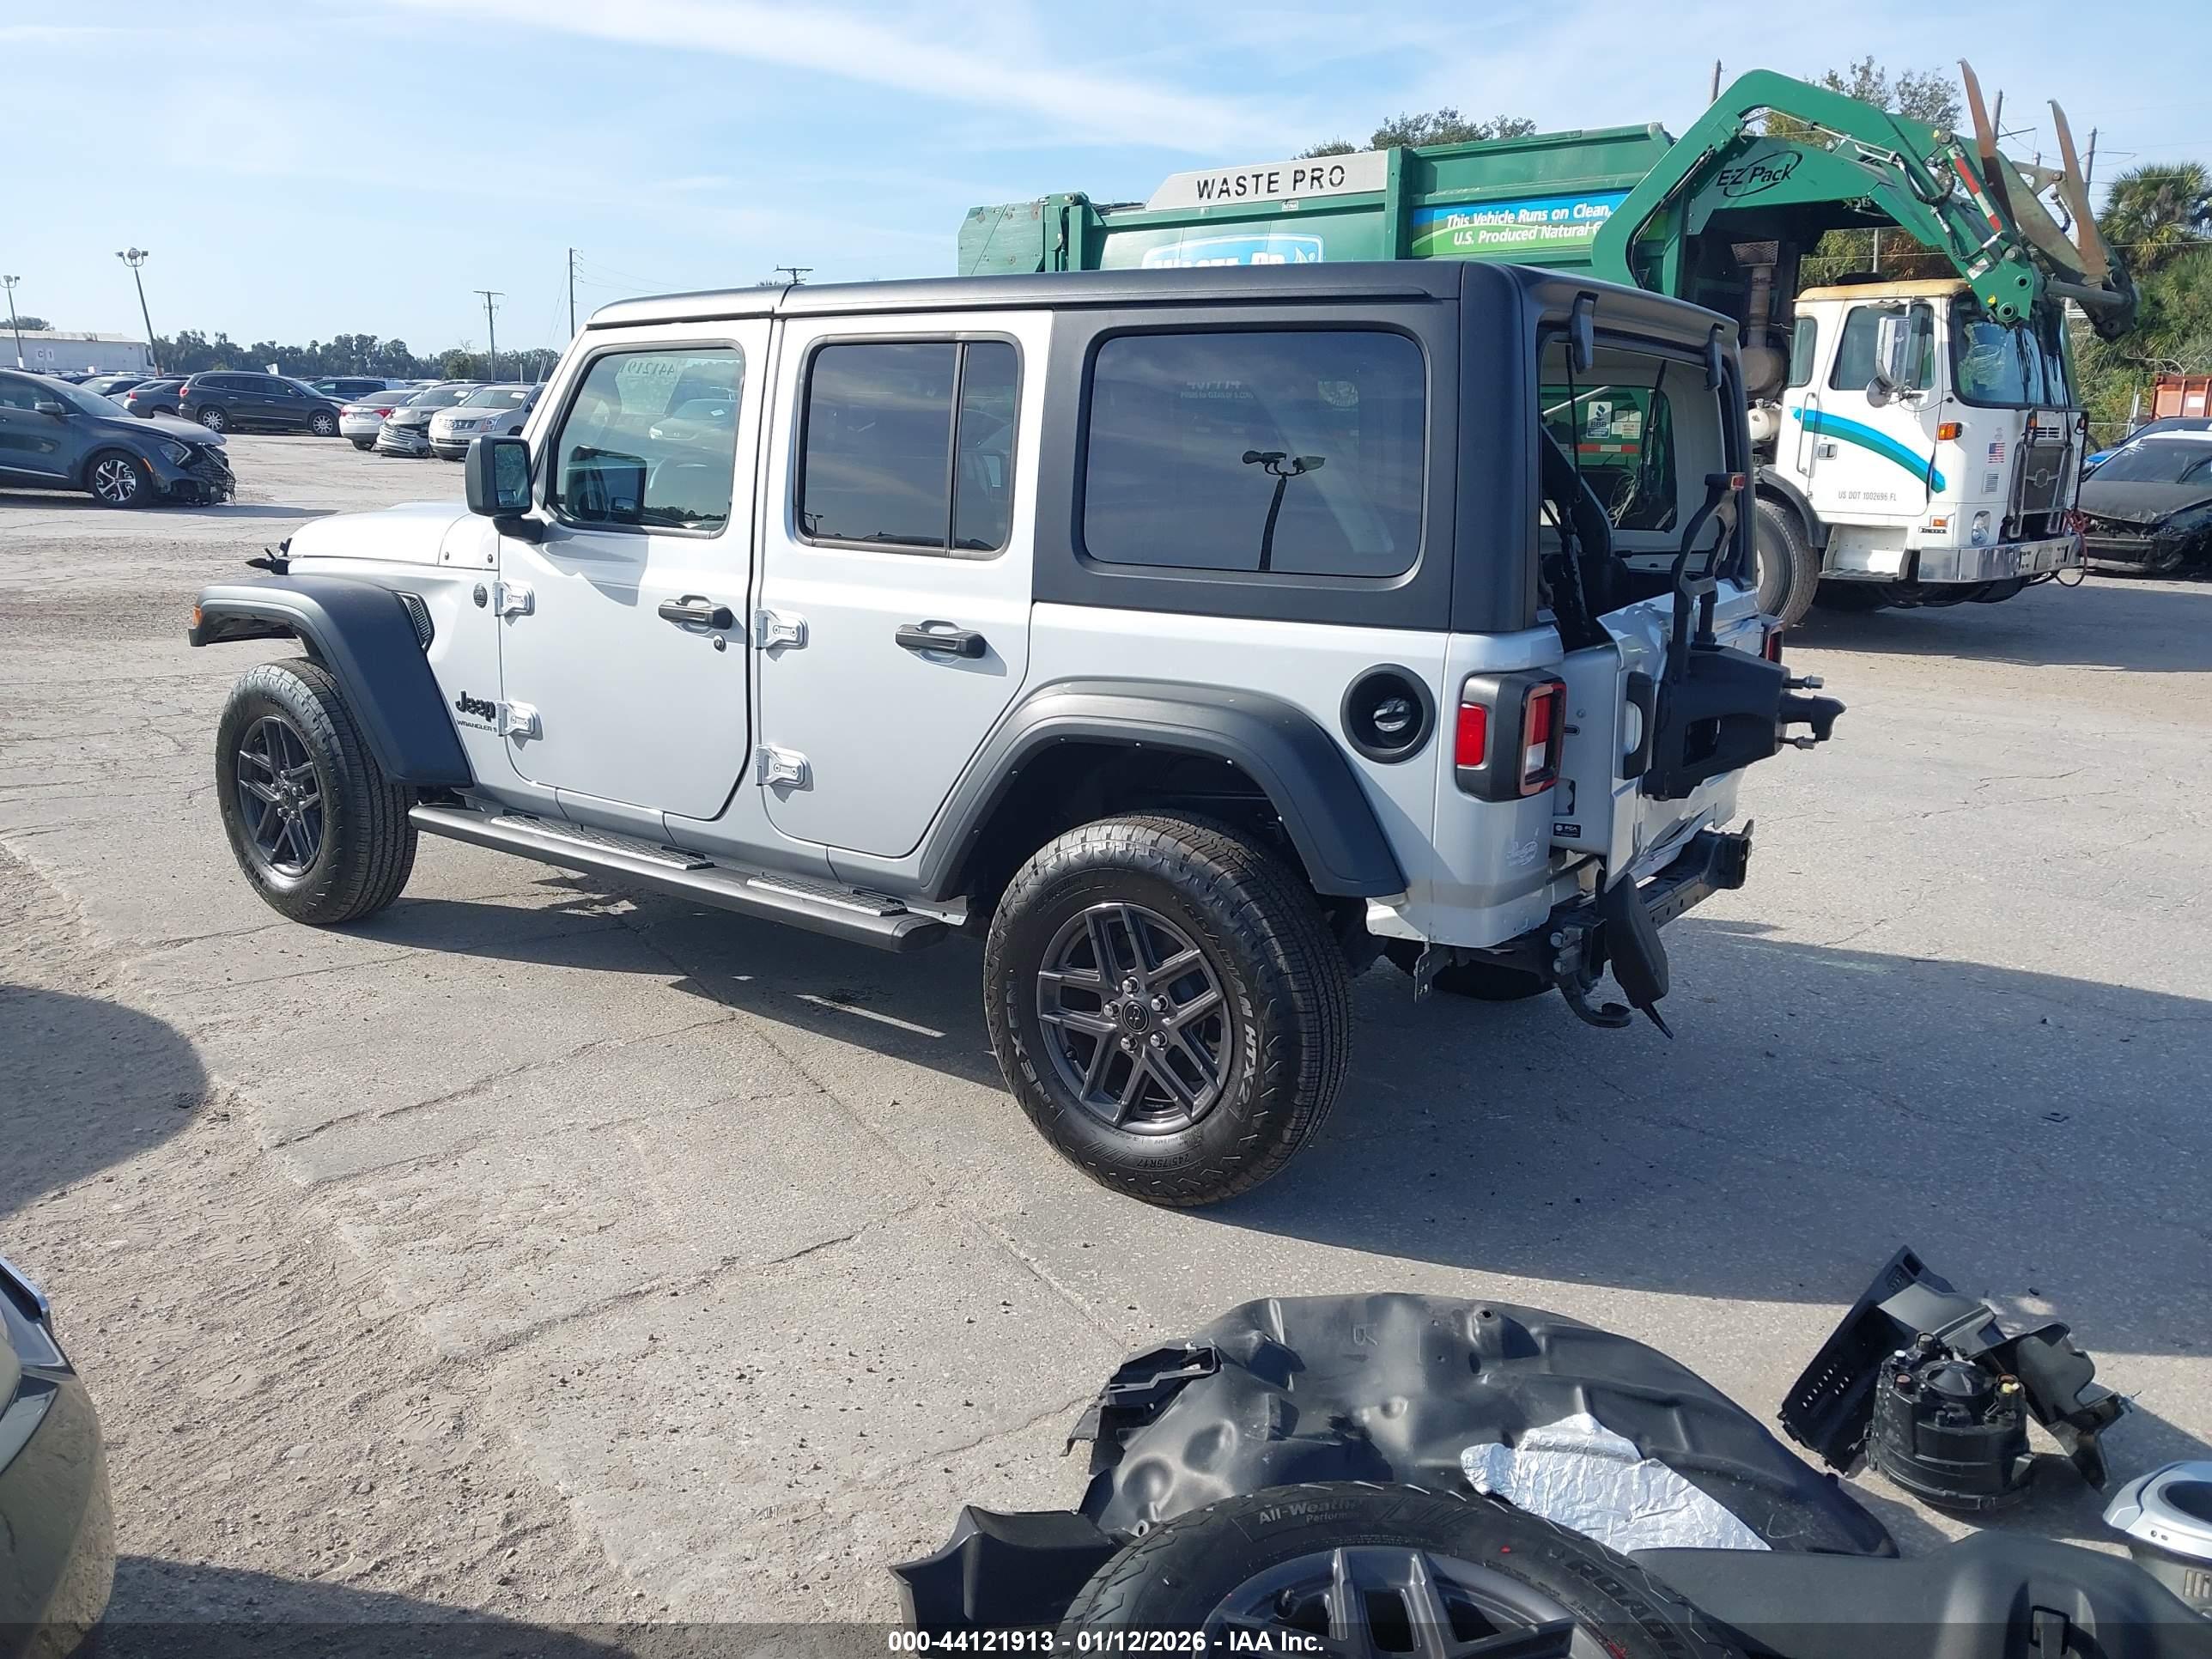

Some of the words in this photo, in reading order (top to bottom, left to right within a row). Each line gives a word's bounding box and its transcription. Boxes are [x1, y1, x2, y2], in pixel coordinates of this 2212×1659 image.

[1196, 171, 1280, 201] WASTE
[1292, 165, 1346, 191] PRO
[1748, 163, 1791, 184] Pack
[1446, 213, 1470, 228] This
[1473, 210, 1515, 226] Vehicle
[1518, 208, 1548, 222] Runs
[1551, 208, 1569, 220] on
[1453, 231, 1474, 246] U.S.
[1478, 226, 1538, 245] Produced
[1540, 222, 1588, 240] Natural
[1838, 490, 1847, 500] US
[1848, 490, 1862, 500] DOT
[1889, 492, 1897, 501] FL
[455, 690, 496, 723] Jeep
[456, 719, 493, 732] WRANGLER
[1006, 981, 1053, 1106] NEXEN
[1237, 1022, 1257, 1105] HTX2
